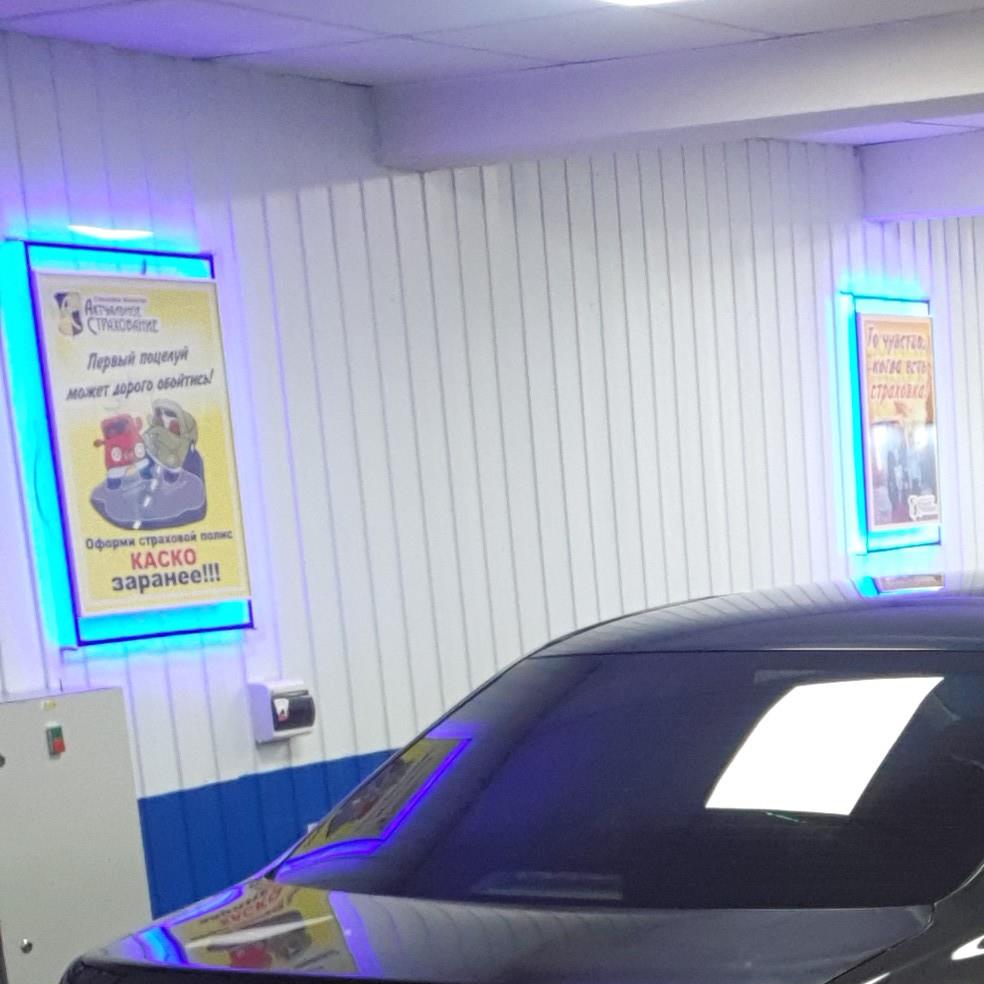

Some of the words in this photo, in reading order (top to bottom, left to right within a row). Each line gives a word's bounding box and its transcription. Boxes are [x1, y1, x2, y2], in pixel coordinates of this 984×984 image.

[87, 350, 137, 374] Первый
[139, 345, 190, 366] поцелуй
[66, 384, 110, 401] может
[112, 379, 154, 399] дорого
[157, 367, 215, 391] обойтись!
[85, 537, 136, 552] Оформи
[138, 530, 198, 548] страховой
[200, 530, 234, 541] полис
[130, 547, 198, 571] КАСКО
[111, 562, 221, 595] заранее!!!
